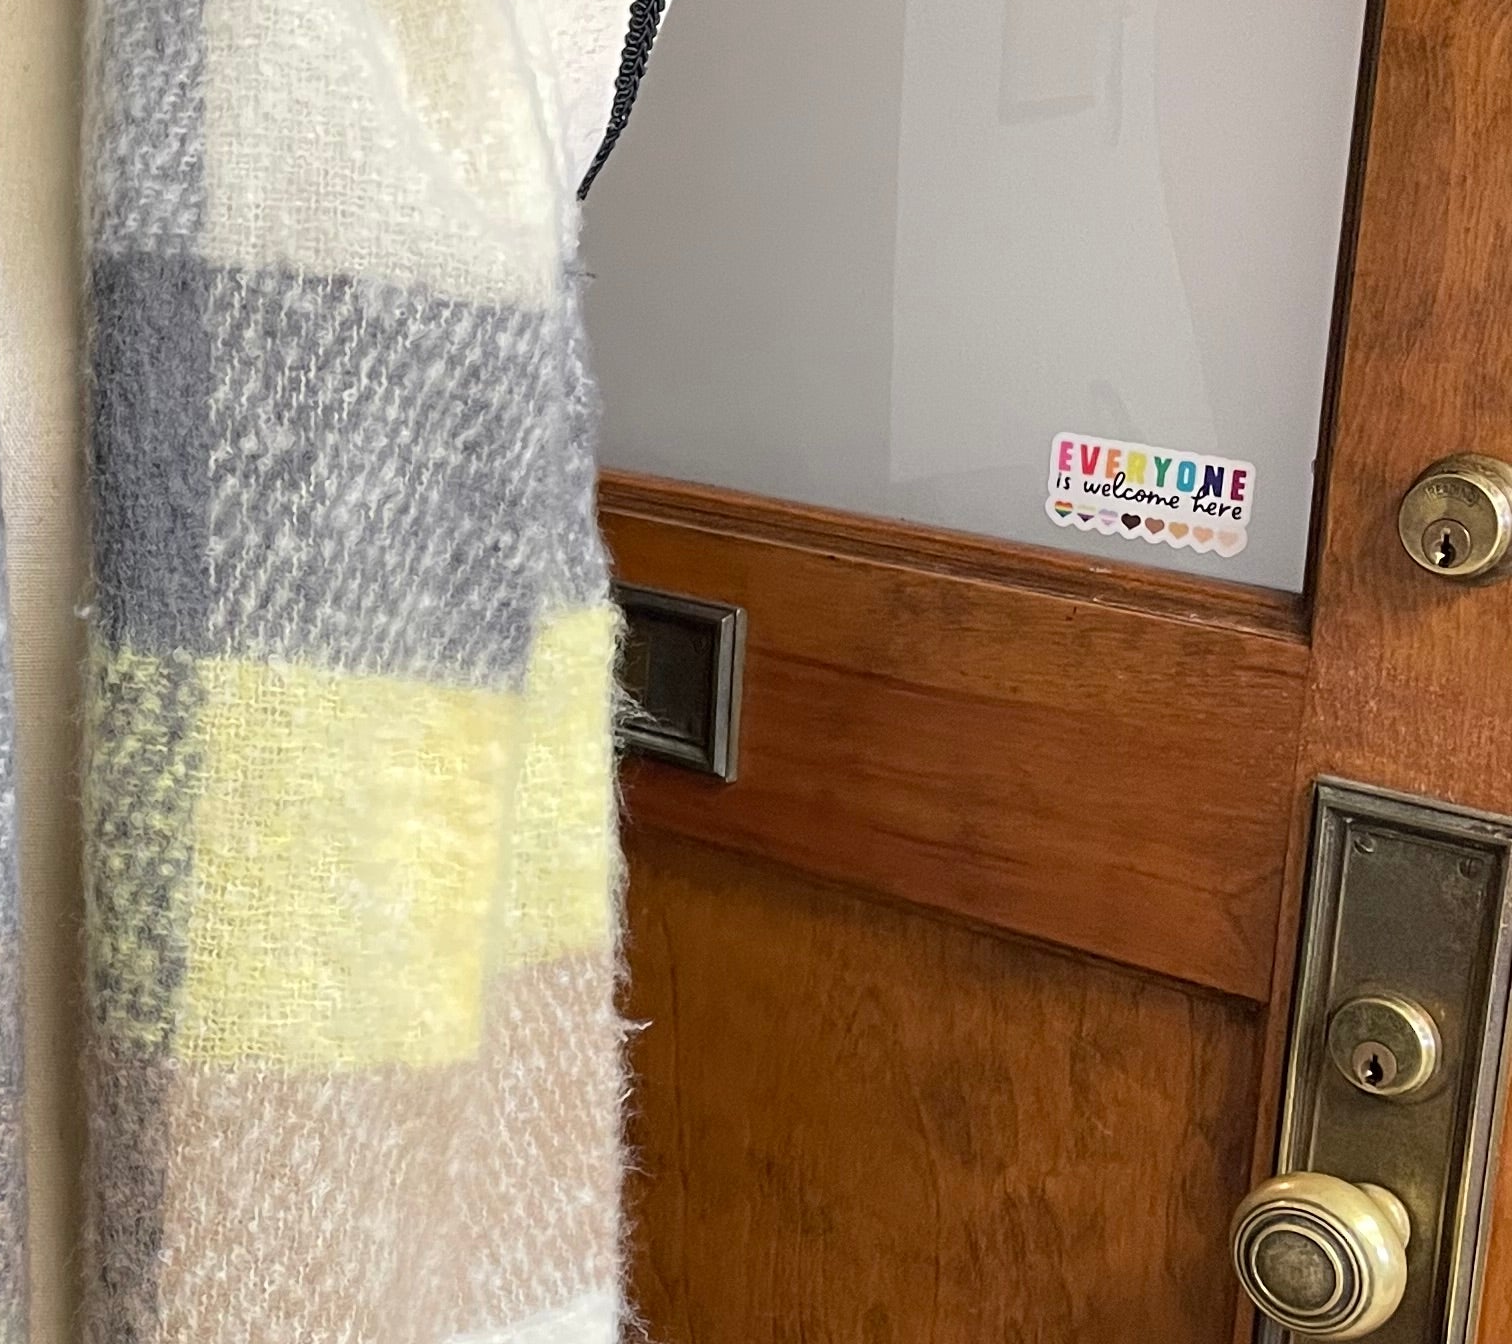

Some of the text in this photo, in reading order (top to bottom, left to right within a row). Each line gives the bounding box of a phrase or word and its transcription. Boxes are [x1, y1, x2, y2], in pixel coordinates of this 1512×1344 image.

[1056, 471, 1242, 520] is welcome here
[1058, 440, 1247, 502] EVERYONE
